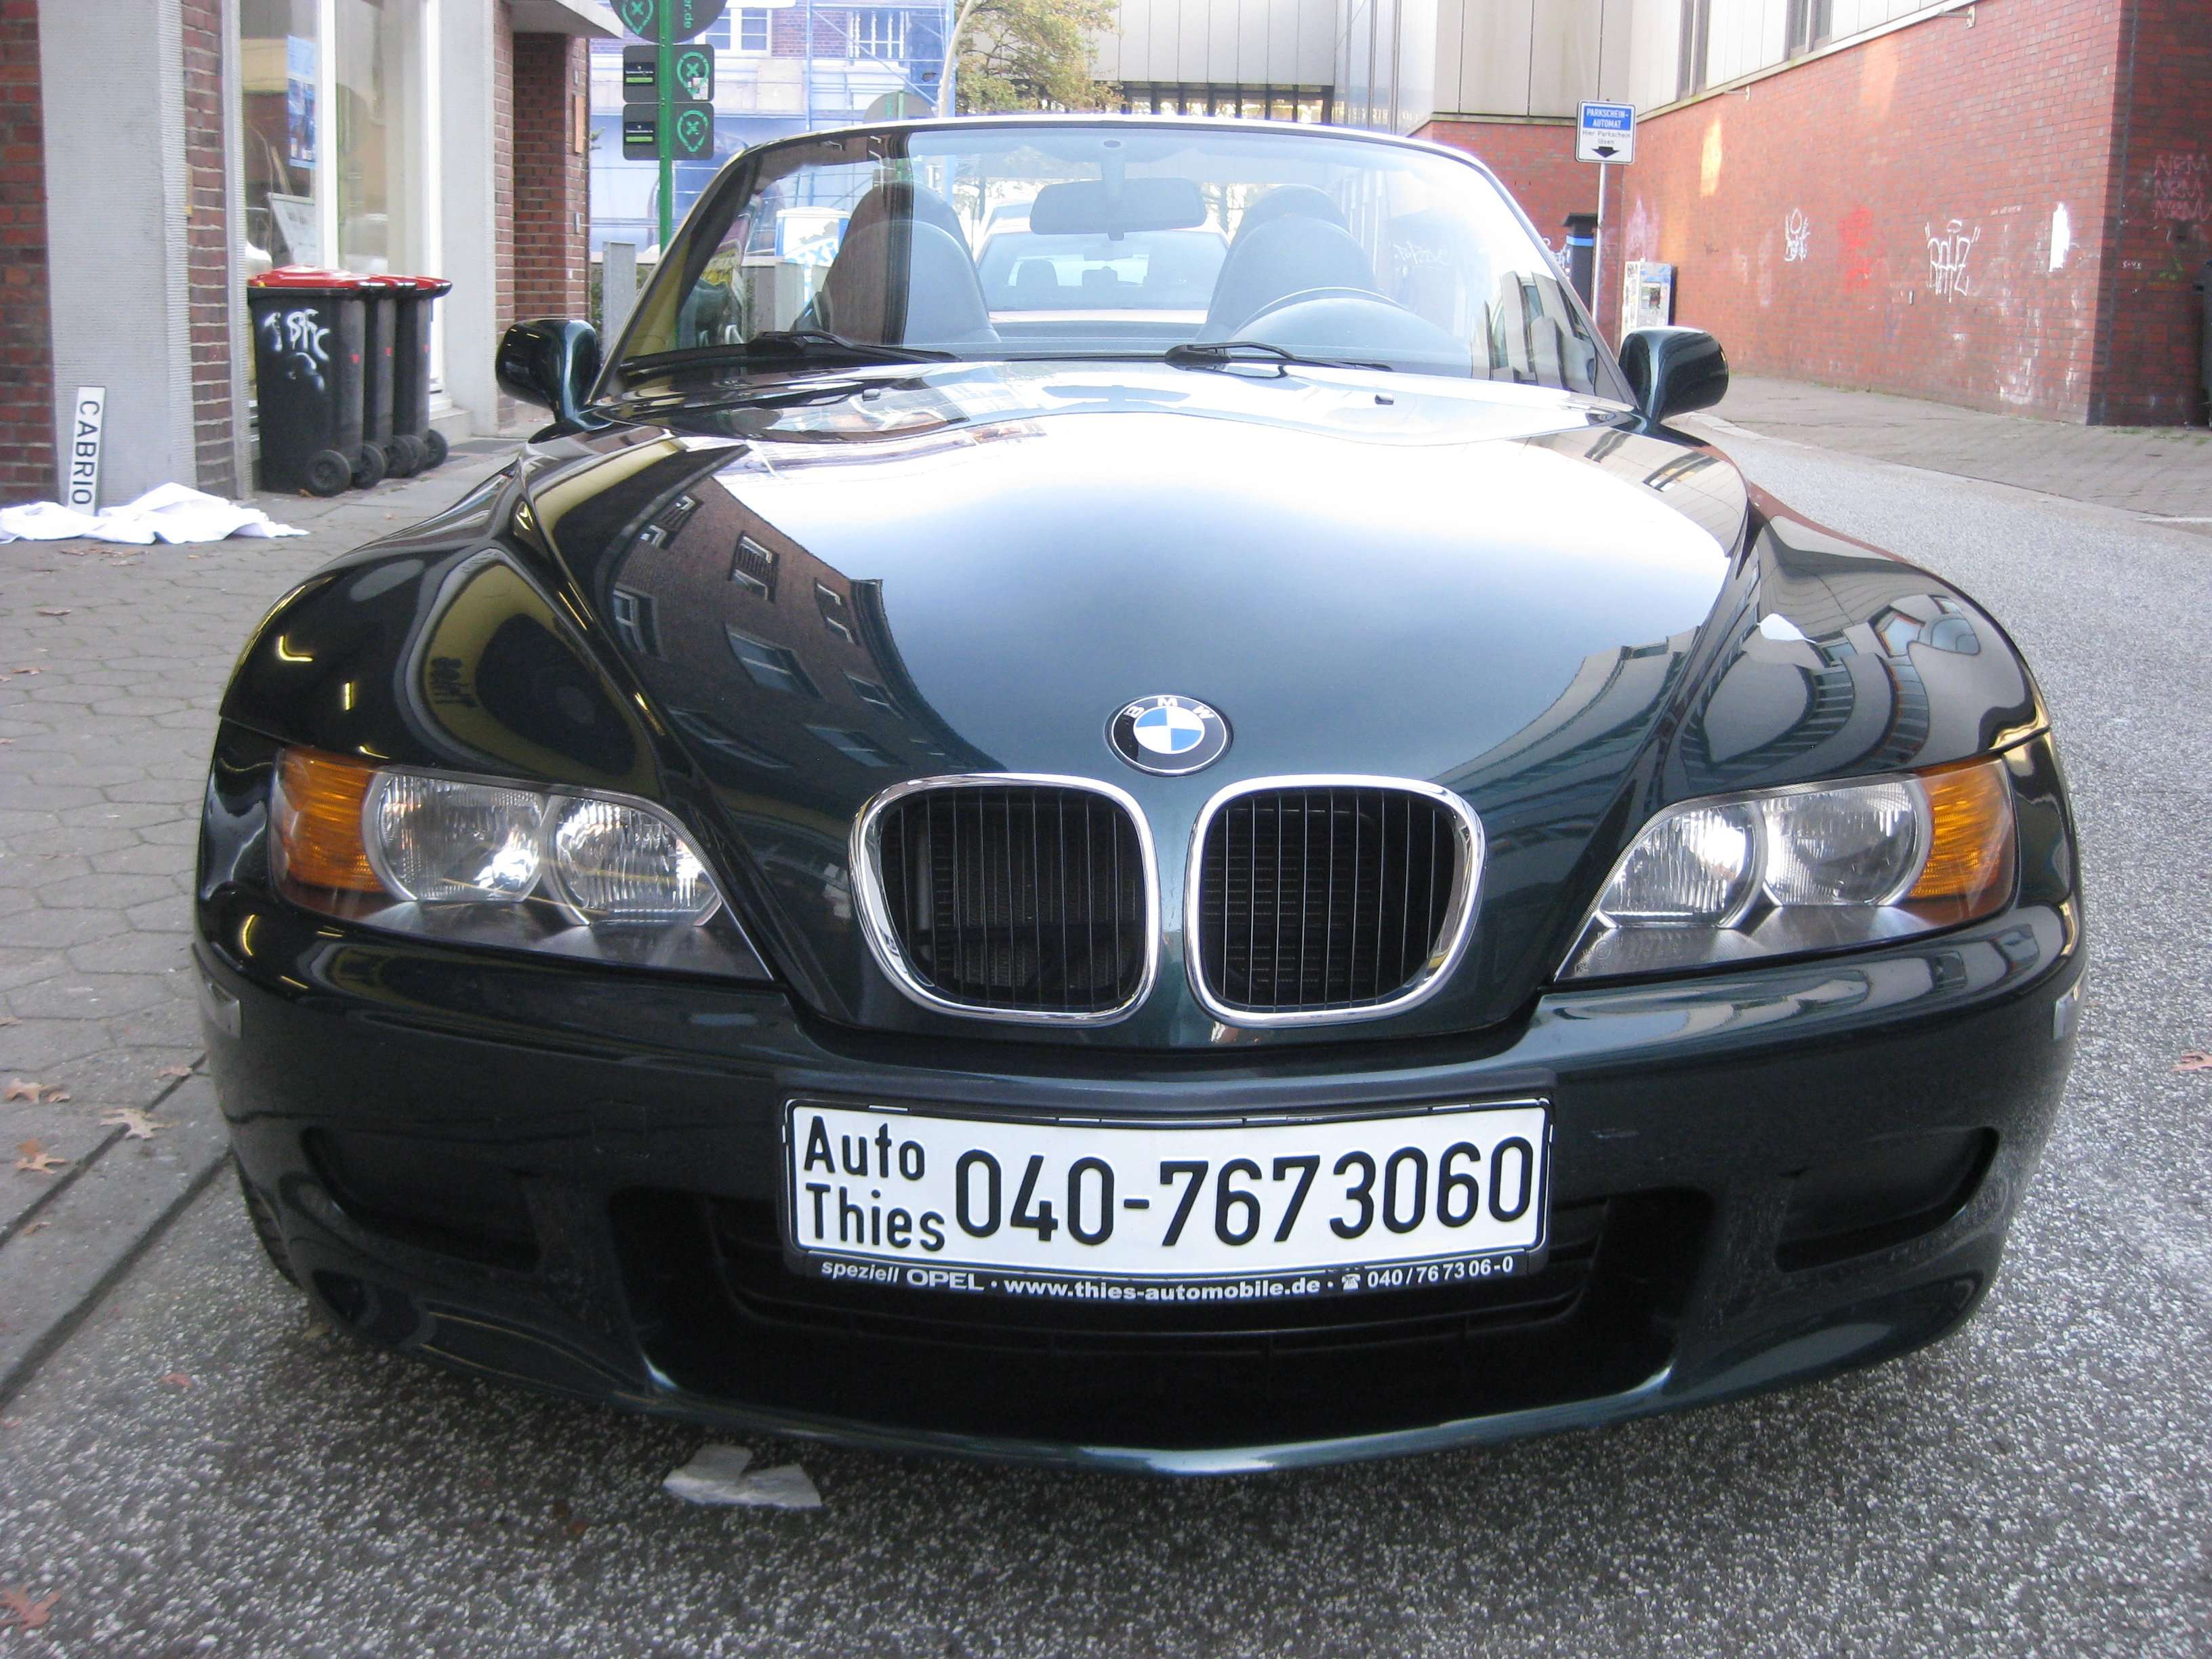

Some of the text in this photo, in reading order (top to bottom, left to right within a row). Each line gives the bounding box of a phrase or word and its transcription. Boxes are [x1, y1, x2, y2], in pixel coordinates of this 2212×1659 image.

[1586, 108, 1629, 119] PARKSCHEIN-
[1593, 119, 1622, 129] AUTOMAT
[72, 401, 100, 505] CABRIO
[1124, 697, 1215, 719] BMW
[804, 1115, 925, 1181] Auto
[806, 1183, 945, 1251] Thies
[956, 1136, 1534, 1246] 040-7673060
[821, 1261, 900, 1283] speziell
[906, 1269, 985, 1291] OPEL
[1004, 1278, 1320, 1300] www.thies-automobile.de
